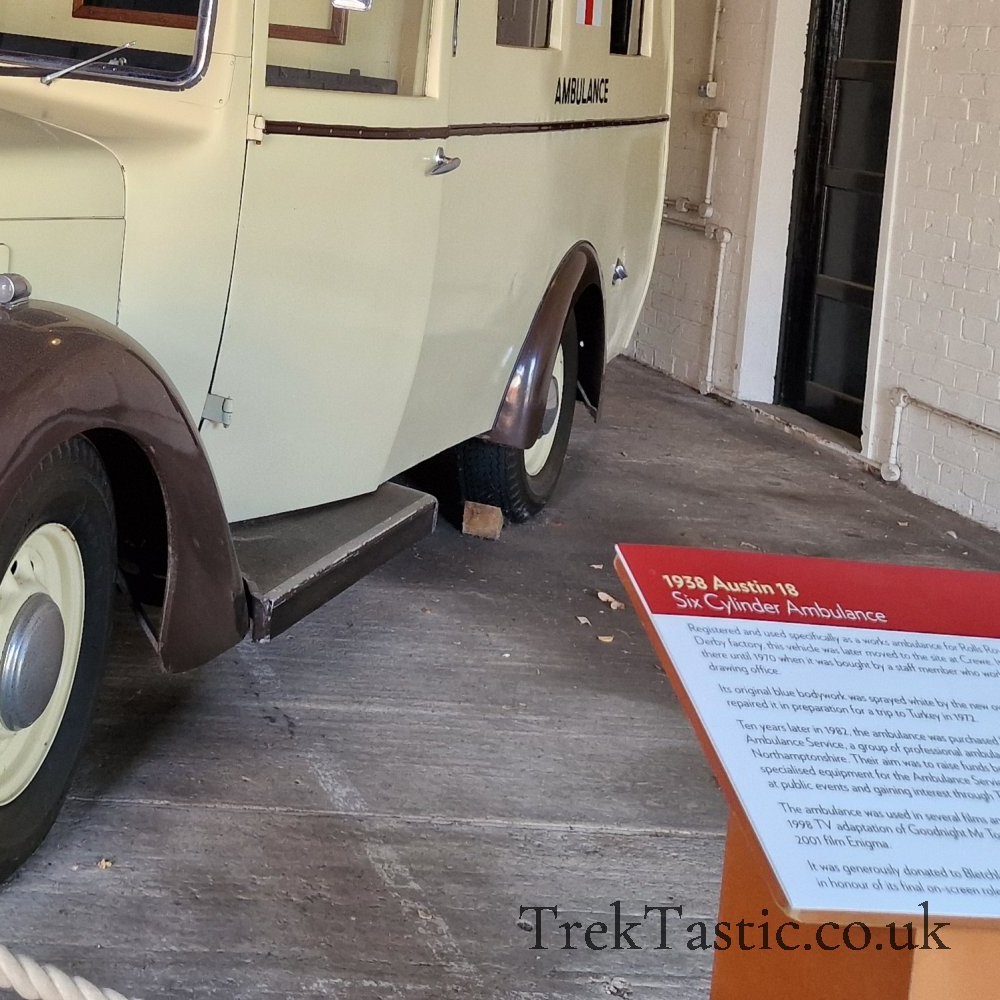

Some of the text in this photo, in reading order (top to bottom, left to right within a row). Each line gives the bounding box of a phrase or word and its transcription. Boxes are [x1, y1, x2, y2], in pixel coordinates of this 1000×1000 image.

[554, 77, 609, 105] AMBULANCE
[662, 574, 799, 597] 1938 Austin 18
[672, 591, 888, 623] Six Cylinder Ambulance
[687, 623, 741, 636] Registered
[743, 627, 762, 637] and
[763, 628, 787, 638] used
[789, 631, 839, 644] specifically
[843, 636, 853, 644] as
[862, 637, 890, 647] works
[892, 639, 942, 650] ambulance
[943, 642, 957, 651] for
[694, 636, 726, 648] Derby
[766, 641, 784, 650] this
[787, 643, 821, 653] vehicle
[842, 646, 862, 656] later
[865, 650, 899, 660] moved
[900, 651, 911, 660] to
[912, 652, 928, 661] the
[930, 655, 947, 663] site
[702, 649, 728, 659] there
[730, 651, 752, 661] until
[753, 653, 777, 662] 1970
[778, 654, 805, 664] when
[807, 656, 815, 665] it
[815, 658, 834, 667] was
[835, 658, 870, 671] bought
[871, 661, 885, 672] by
[895, 663, 916, 672] staff
[918, 666, 958, 676] member
[960, 668, 981, 677] who
[709, 662, 749, 675] drawing
[718, 684, 732, 693] Its
[734, 686, 772, 697] original
[772, 687, 795, 697] blue
[796, 688, 846, 701] bodywork
[868, 696, 907, 706] sprayed
[908, 696, 935, 707] white
[935, 697, 949, 710] by
[950, 699, 968, 710] the
[727, 699, 768, 709] repaired
[770, 700, 778, 709] it
[780, 701, 790, 710] in
[791, 702, 849, 714] preparation
[849, 704, 865, 715] for
[875, 708, 893, 719] trip
[894, 709, 906, 718] to
[905, 708, 941, 722] Turkey
[942, 712, 953, 721] in
[736, 719, 757, 730] Ten
[759, 723, 785, 733] years
[786, 723, 811, 733] later
[813, 725, 823, 734] in
[852, 726, 870, 737] the
[872, 728, 926, 741] ambulance
[928, 734, 948, 743] was
[948, 735, 999, 745] purchased
[746, 734, 805, 747] Ambulance
[805, 737, 848, 750] Service,
[858, 743, 888, 754] group
[890, 743, 902, 752] of
[903, 744, 963, 757] professional
[850, 753, 879, 764] Their
[882, 756, 902, 766] aim
[902, 760, 922, 768] was
[922, 761, 934, 769] to
[936, 761, 960, 770] raise
[960, 760, 991, 772] funds
[760, 764, 816, 776] specialised
[818, 769, 875, 780] equipment
[874, 769, 891, 779] for
[892, 770, 911, 781] the
[912, 771, 971, 785] Ambulance
[768, 780, 779, 789] at
[780, 779, 814, 791] public
[815, 783, 849, 792] events
[852, 783, 871, 794] and
[873, 785, 913, 798] gaining
[913, 787, 951, 798] interest
[952, 789, 994, 803] through
[778, 802, 802, 814] The
[805, 804, 862, 817] ambulance
[864, 810, 884, 818] was
[886, 809, 911, 820] used
[912, 810, 923, 820] in
[925, 811, 961, 822] several
[961, 812, 989, 824] films
[787, 819, 813, 830] 1998
[813, 818, 832, 830] TV
[837, 821, 893, 834] adaptation
[895, 823, 906, 834] of
[907, 824, 967, 840] Goodnight
[967, 828, 984, 839] Mr
[795, 835, 821, 845] 2001
[823, 834, 846, 847] film
[807, 860, 817, 871] It
[819, 864, 841, 873] was
[842, 864, 900, 878] generously
[903, 864, 948, 878] donated
[949, 869, 962, 878] to
[816, 878, 827, 888] in
[829, 878, 869, 890] honour
[872, 879, 883, 890] of
[886, 880, 899, 891] its
[899, 880, 925, 894] final
